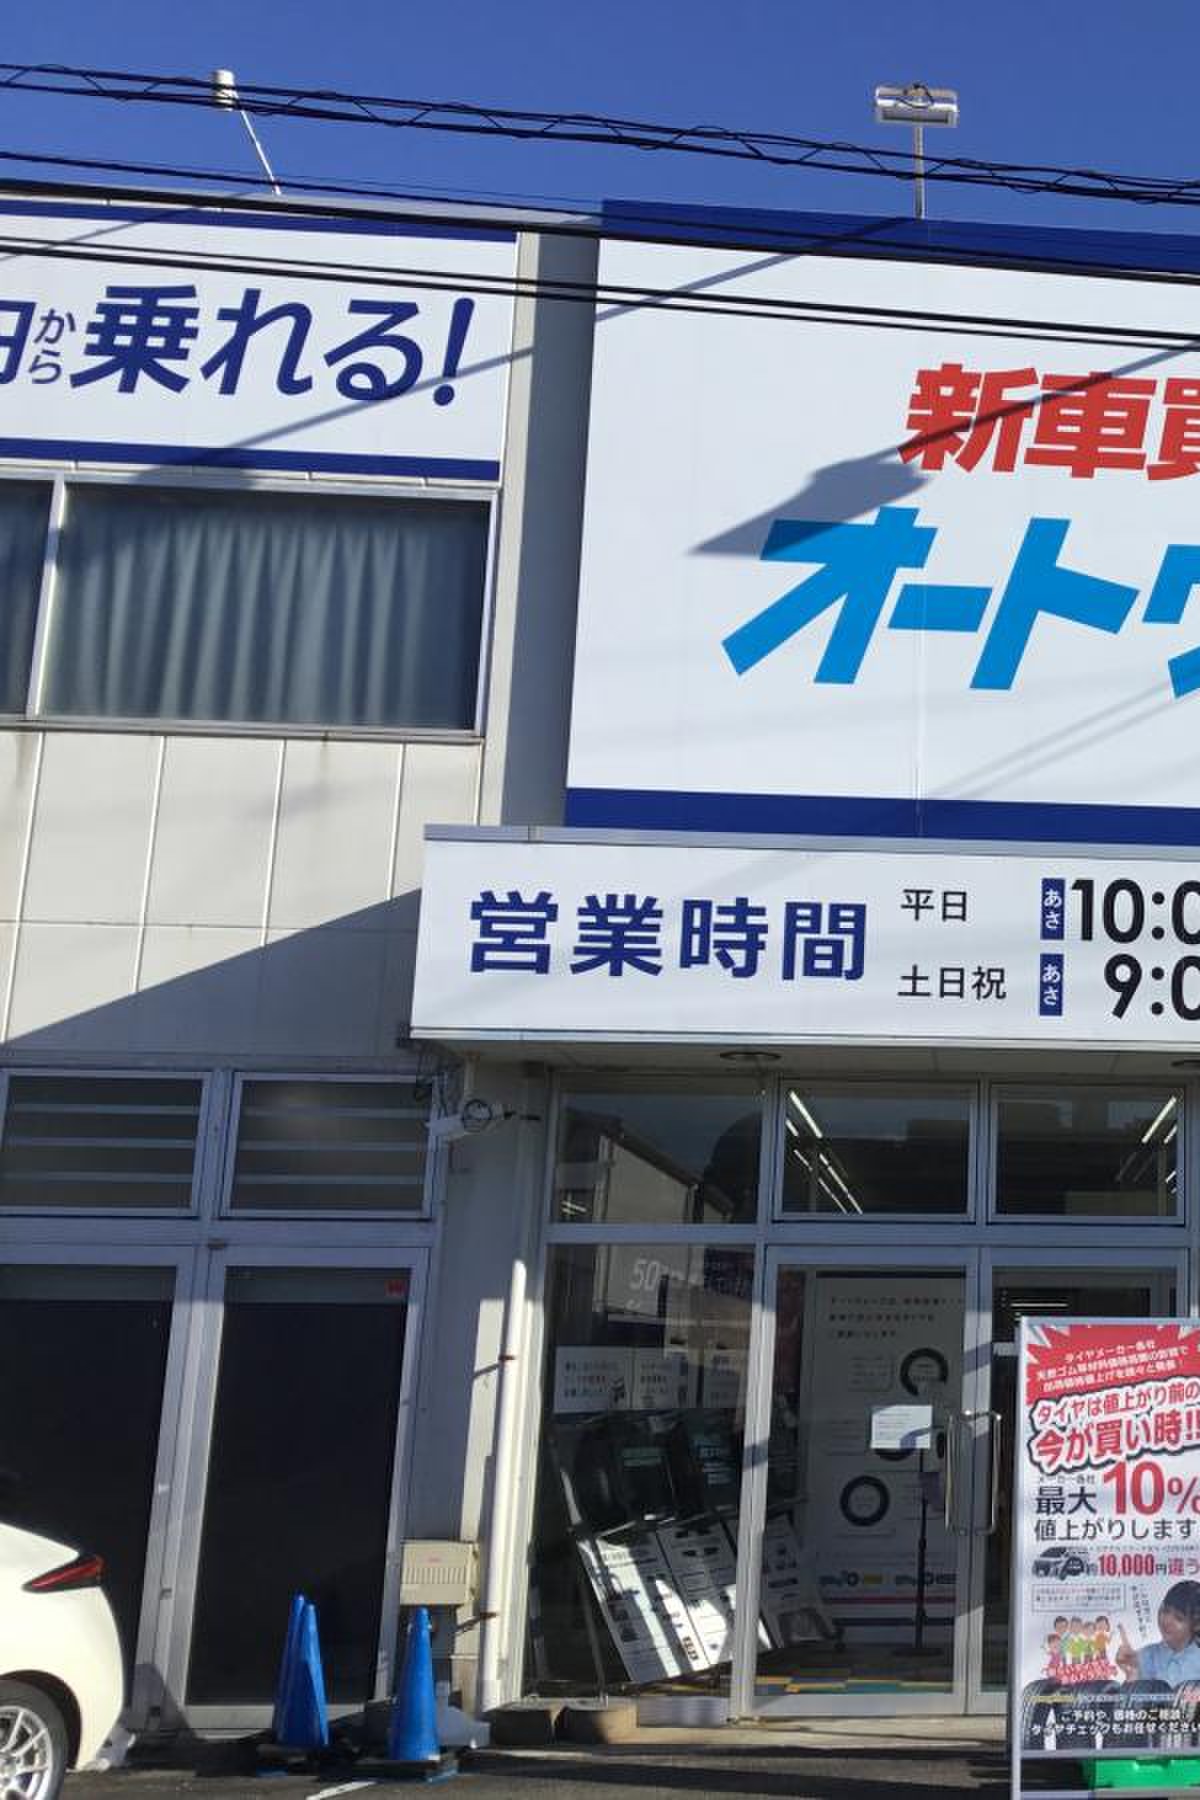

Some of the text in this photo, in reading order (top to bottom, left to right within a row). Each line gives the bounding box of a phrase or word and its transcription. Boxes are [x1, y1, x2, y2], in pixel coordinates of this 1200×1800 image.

[901, 888, 969, 923] 平日
[1043, 886, 1062, 934] あさ
[469, 889, 868, 982] 営業時間
[897, 965, 1007, 1002] 土日祝
[1041, 961, 1061, 1010] あさ
[1038, 1380, 1200, 1424] タイヤは値上がり前の
[1035, 1486, 1097, 1516] 最大
